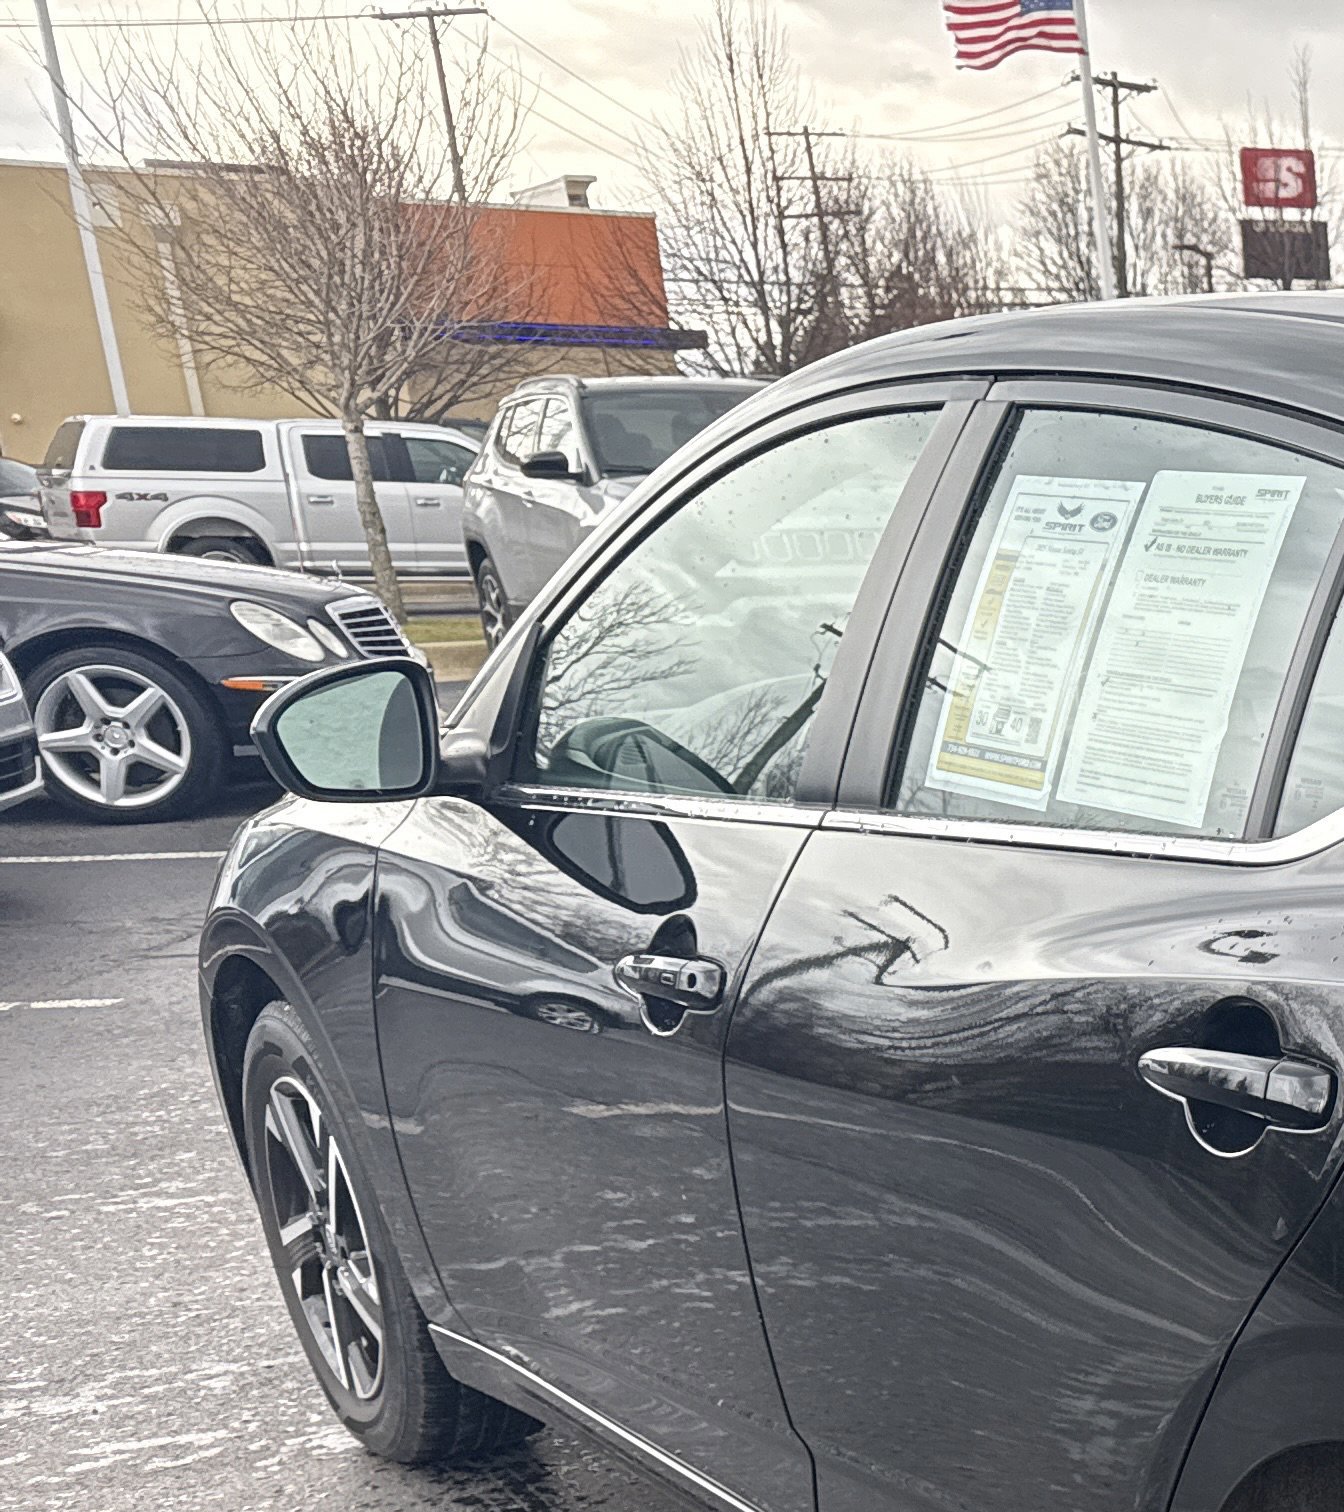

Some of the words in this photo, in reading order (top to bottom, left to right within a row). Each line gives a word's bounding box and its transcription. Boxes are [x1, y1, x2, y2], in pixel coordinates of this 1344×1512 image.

[1224, 494, 1247, 506] GUIDE
[1256, 488, 1291, 500] SPIRIT
[1042, 521, 1086, 533] SPIRIT
[1186, 545, 1212, 556] DEALER
[1212, 547, 1249, 558] WARRANTY
[1144, 573, 1170, 584] DEALER
[1170, 575, 1207, 587] WARRANTY
